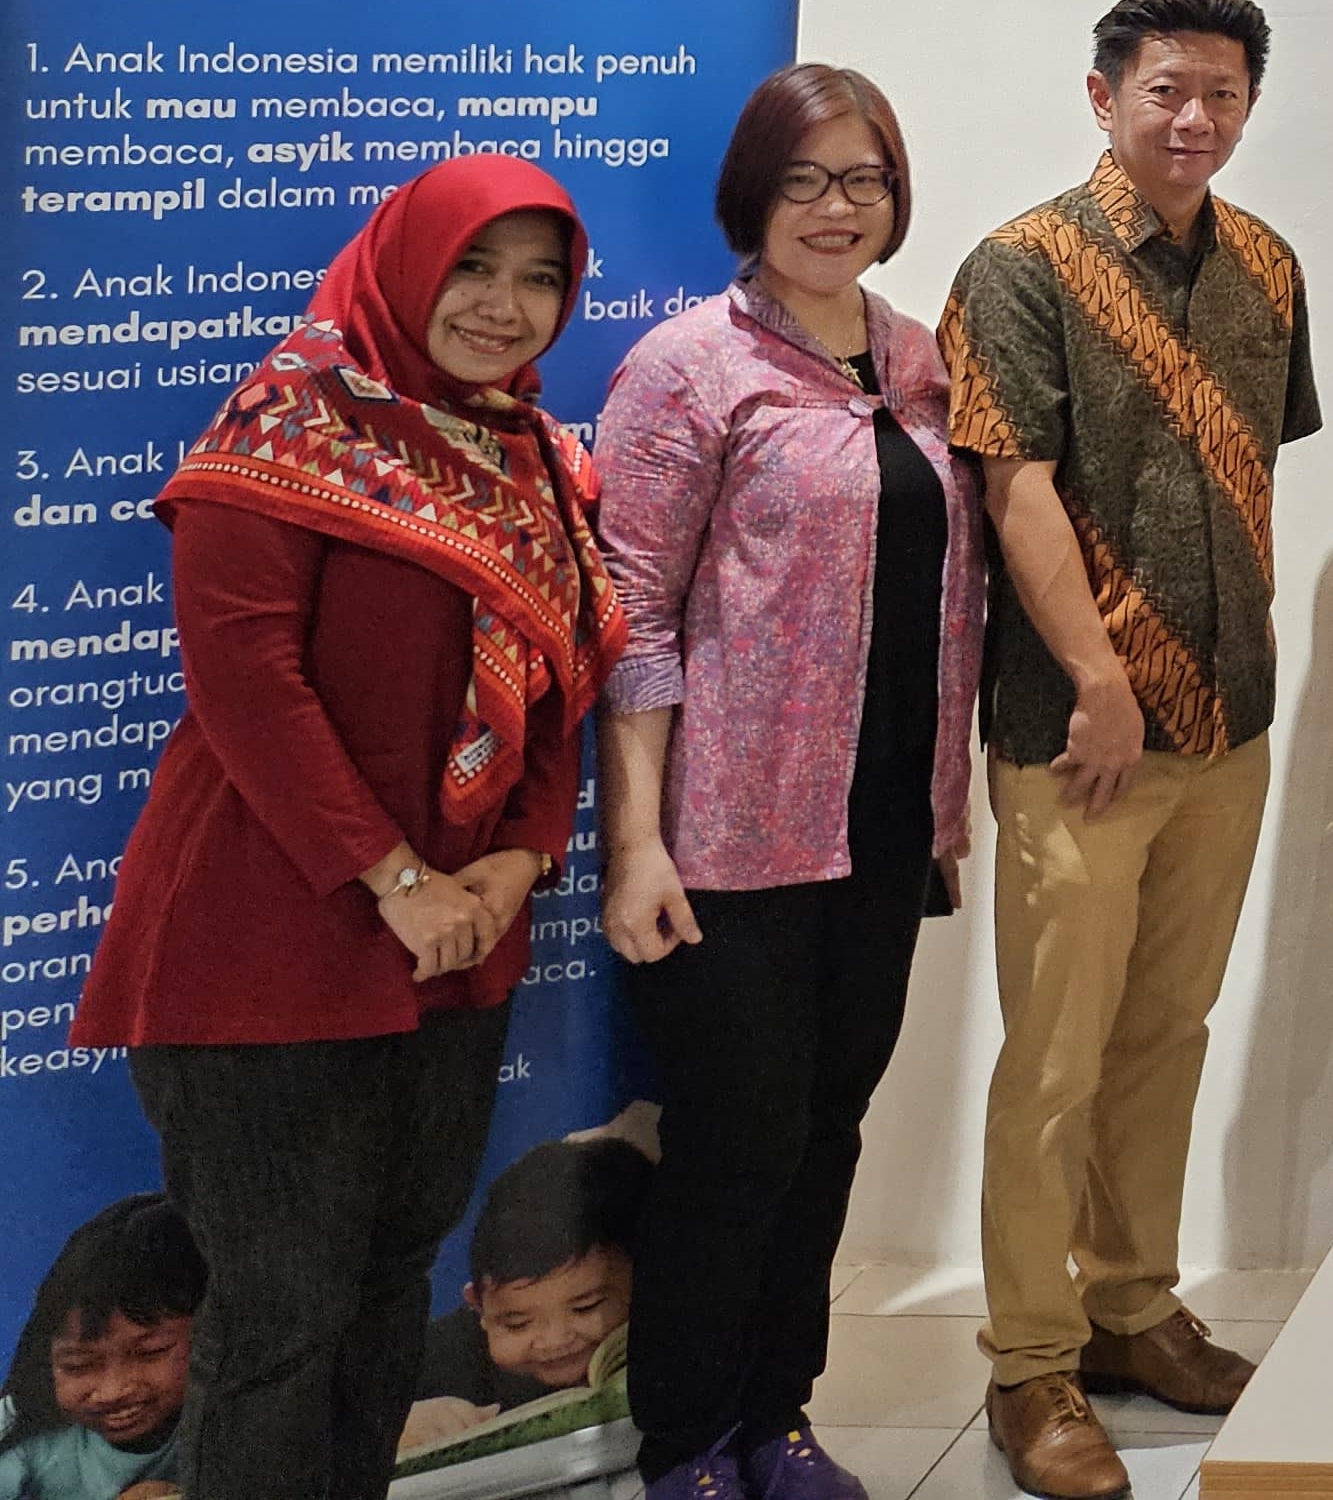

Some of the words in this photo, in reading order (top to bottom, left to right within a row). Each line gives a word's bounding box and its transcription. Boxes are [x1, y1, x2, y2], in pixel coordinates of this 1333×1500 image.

[26, 42, 49, 73] 1.
[64, 41, 164, 73] Anak
[179, 41, 358, 74] Indonesia
[372, 43, 513, 74] memiliki
[524, 43, 585, 74] hak
[596, 44, 696, 83] penuh
[26, 86, 132, 119] untuk
[146, 98, 237, 119] mau
[251, 86, 445, 122] membaca,
[457, 96, 598, 126] mampu
[25, 133, 234, 169] membaca,
[247, 130, 354, 172] asyik
[553, 128, 669, 167] hingga
[21, 177, 205, 221] terampil
[217, 176, 335, 209] dalam
[22, 269, 58, 300] 2.
[73, 263, 173, 299] Anak
[584, 288, 654, 321] baik
[17, 362, 141, 393] sesuai
[157, 359, 263, 387] usian
[16, 450, 49, 480] 3.
[64, 441, 164, 479] Anak
[13, 493, 97, 527] dan
[11, 583, 49, 613] 4.
[64, 571, 164, 611] Anak
[9, 714, 181, 755] mendap
[5, 773, 102, 813] yang
[4, 858, 39, 890] 5.
[1, 994, 84, 1041] pen
